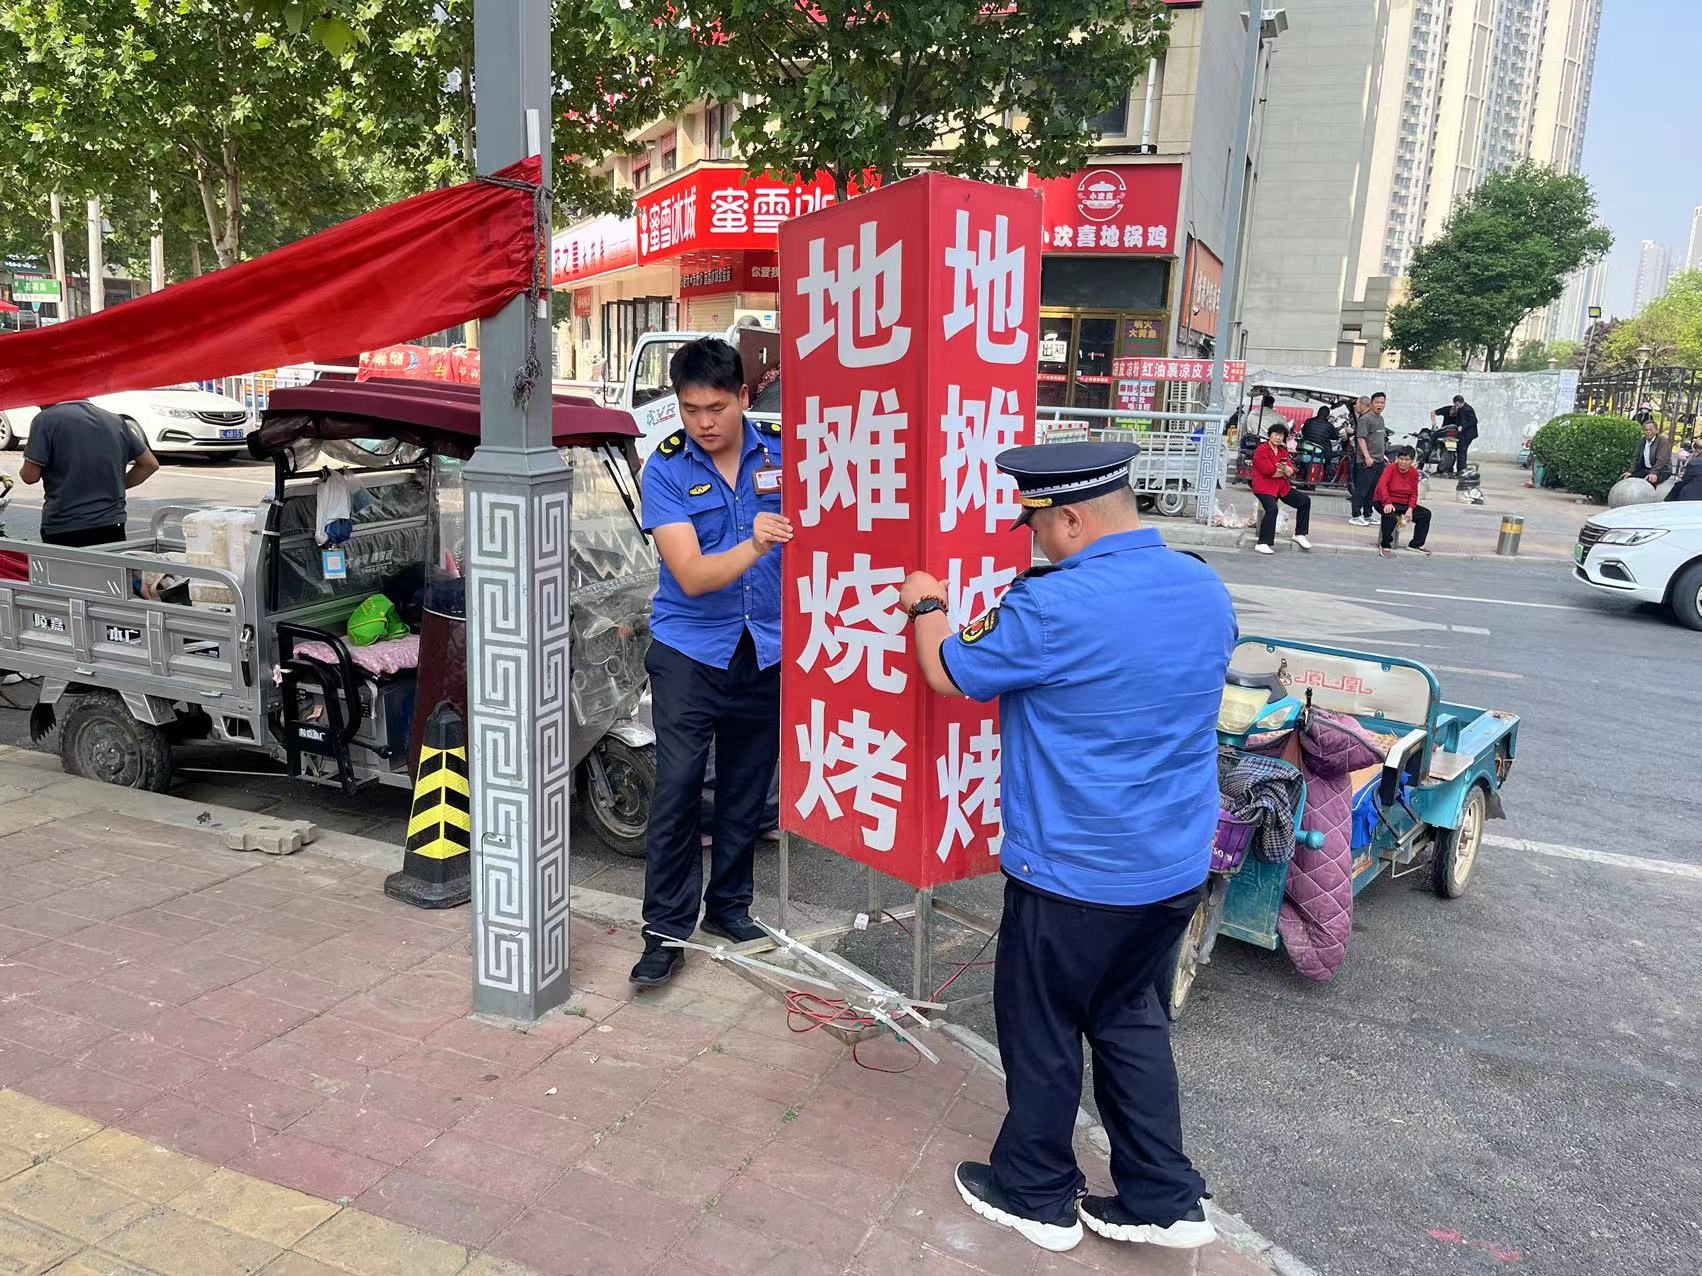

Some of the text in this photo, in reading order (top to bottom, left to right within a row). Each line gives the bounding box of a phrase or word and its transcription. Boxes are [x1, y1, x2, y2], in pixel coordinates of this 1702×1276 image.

[649, 185, 697, 253] 蜜雪冰城
[795, 220, 912, 852] 地摊烧烤
